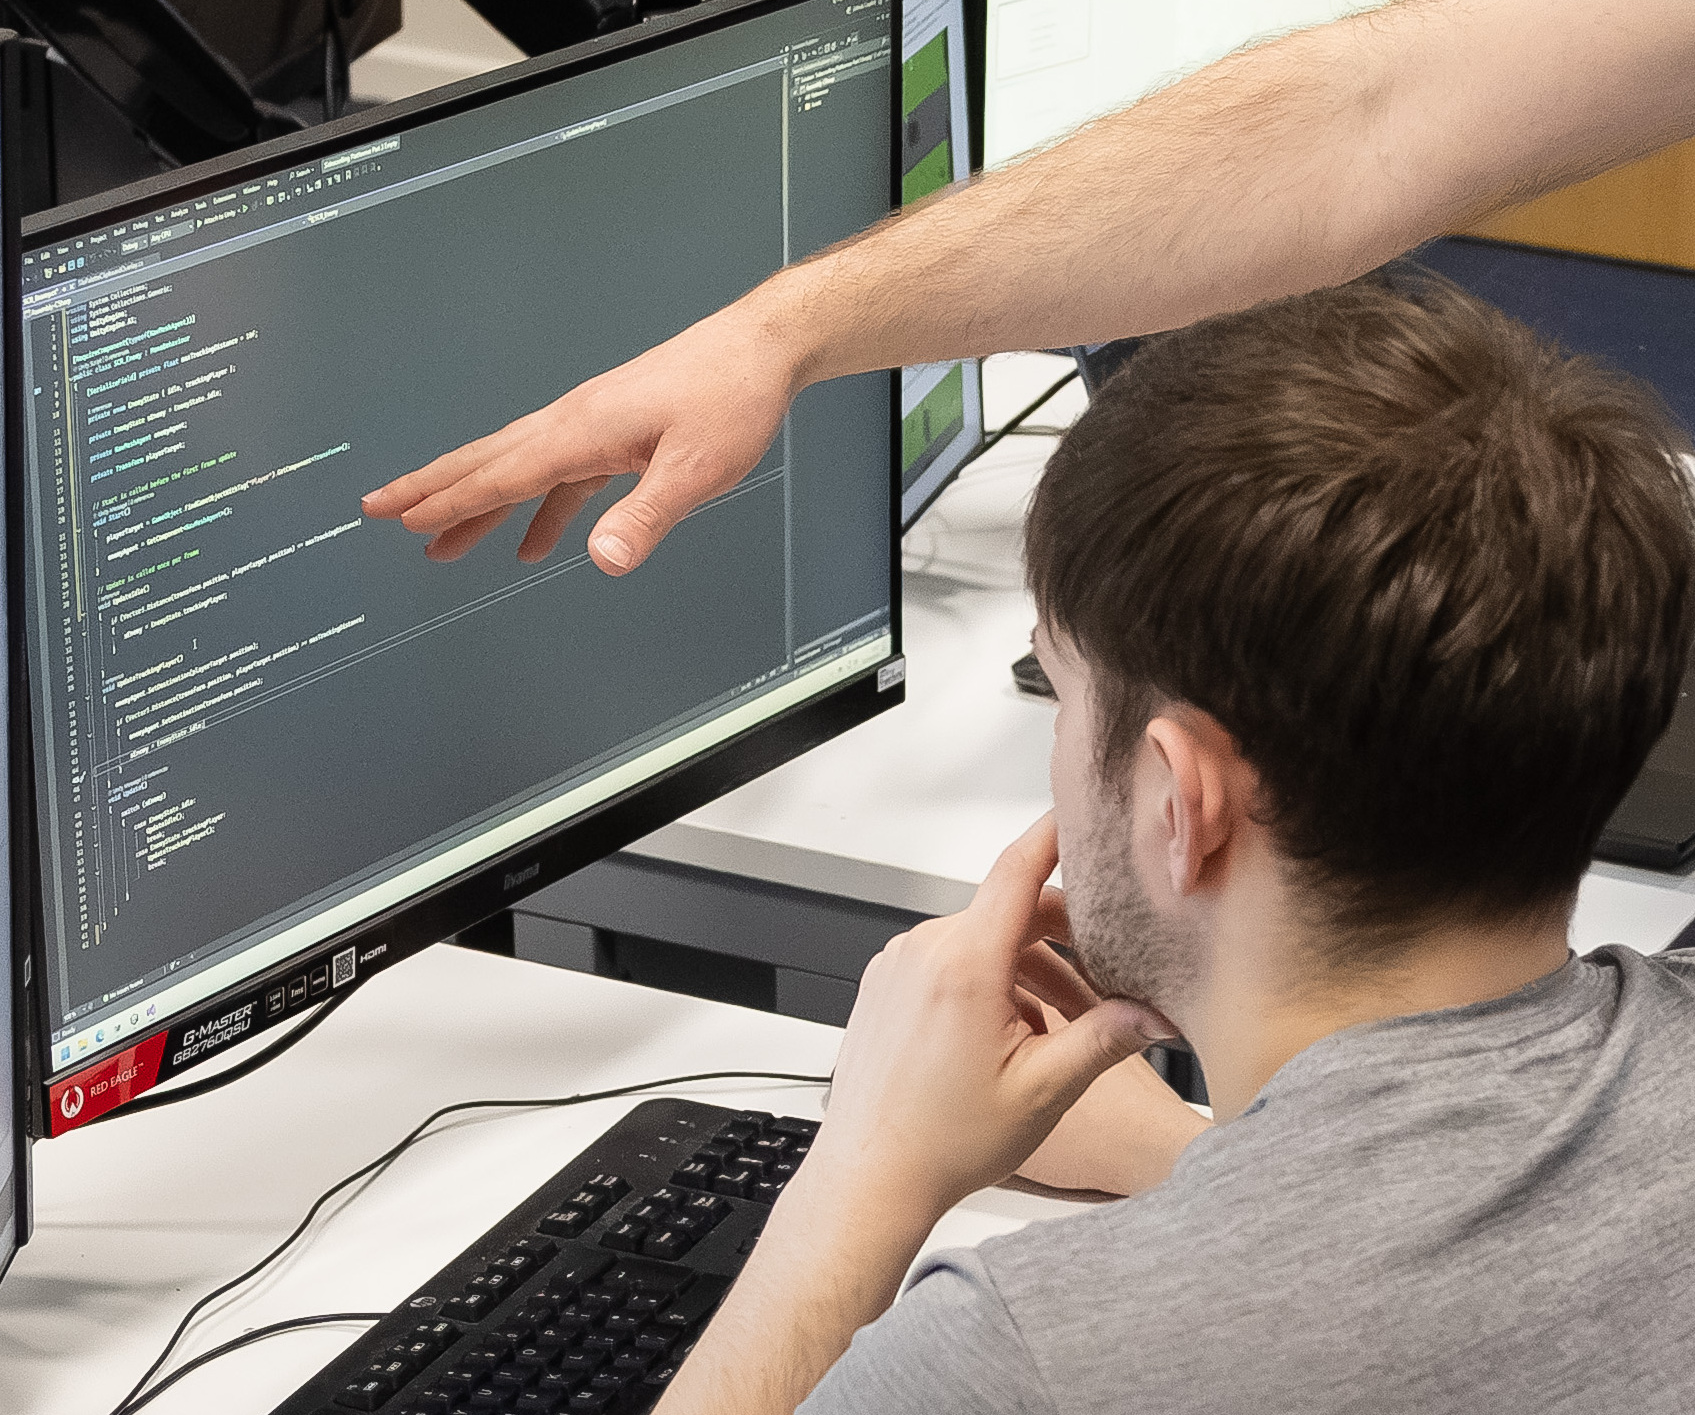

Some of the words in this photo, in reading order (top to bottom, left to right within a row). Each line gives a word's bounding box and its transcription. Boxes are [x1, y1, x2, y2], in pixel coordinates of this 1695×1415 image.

[101, 493, 118, 507] Start
[129, 482, 148, 496] called
[360, 944, 387, 964] HDMI
[172, 1018, 251, 1066] GB2760QSU
[90, 1075, 108, 1098] RED
